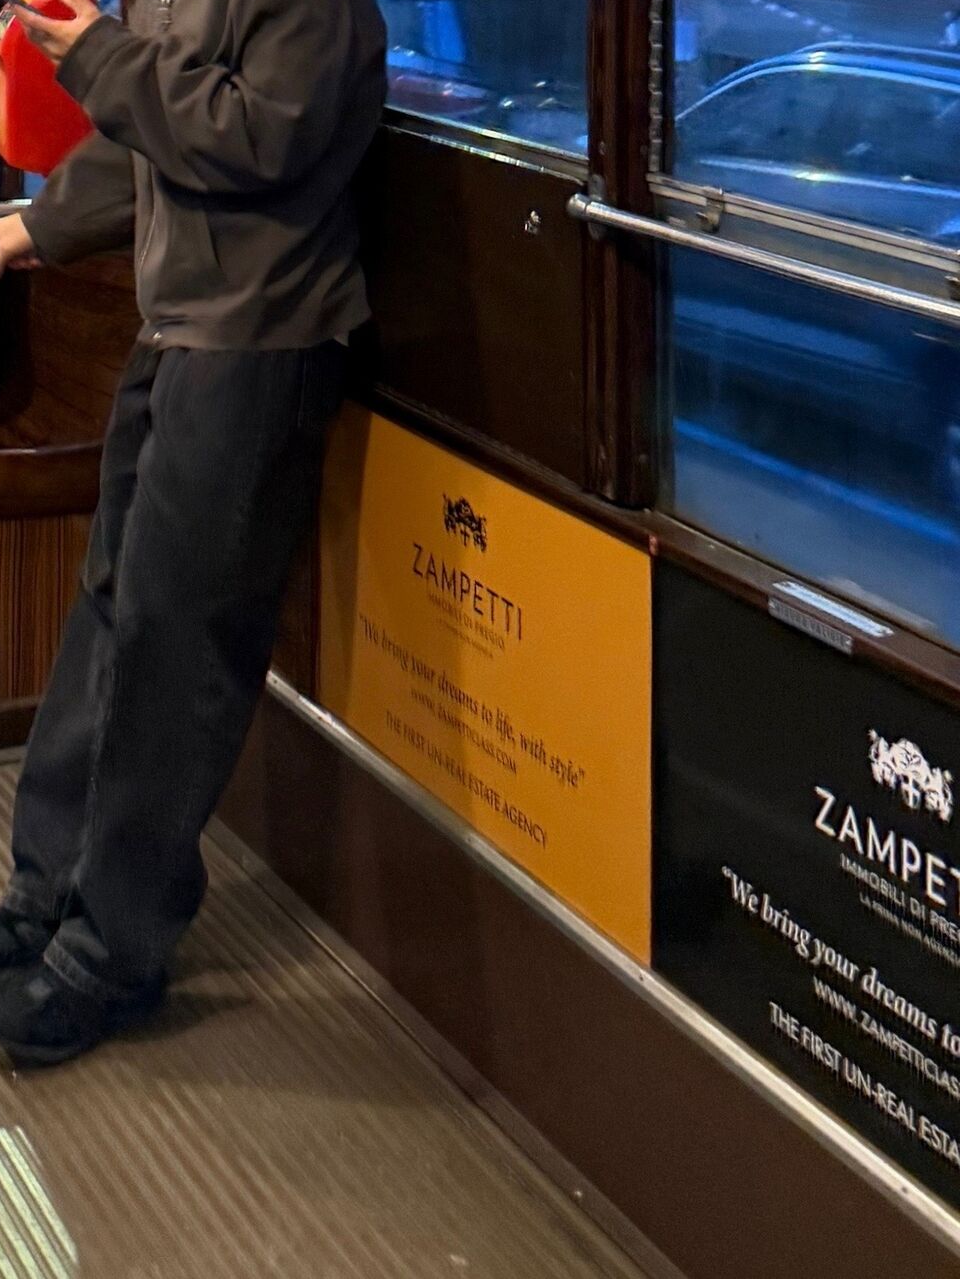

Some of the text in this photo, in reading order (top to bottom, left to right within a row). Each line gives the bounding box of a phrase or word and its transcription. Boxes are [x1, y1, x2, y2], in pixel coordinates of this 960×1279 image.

[413, 542, 523, 641] ZAMPETTI
[481, 704, 493, 726] to
[520, 731, 546, 767] with
[502, 801, 547, 849] AGENCY
[840, 852, 960, 945] IMMOBILI DI PRE
[760, 893, 811, 960] bring
[809, 937, 860, 983] your
[861, 966, 939, 1040] dreams
[769, 1001, 800, 1043] THE
[800, 1026, 842, 1073] FIRST
[843, 1056, 916, 1133] UN-REAL
